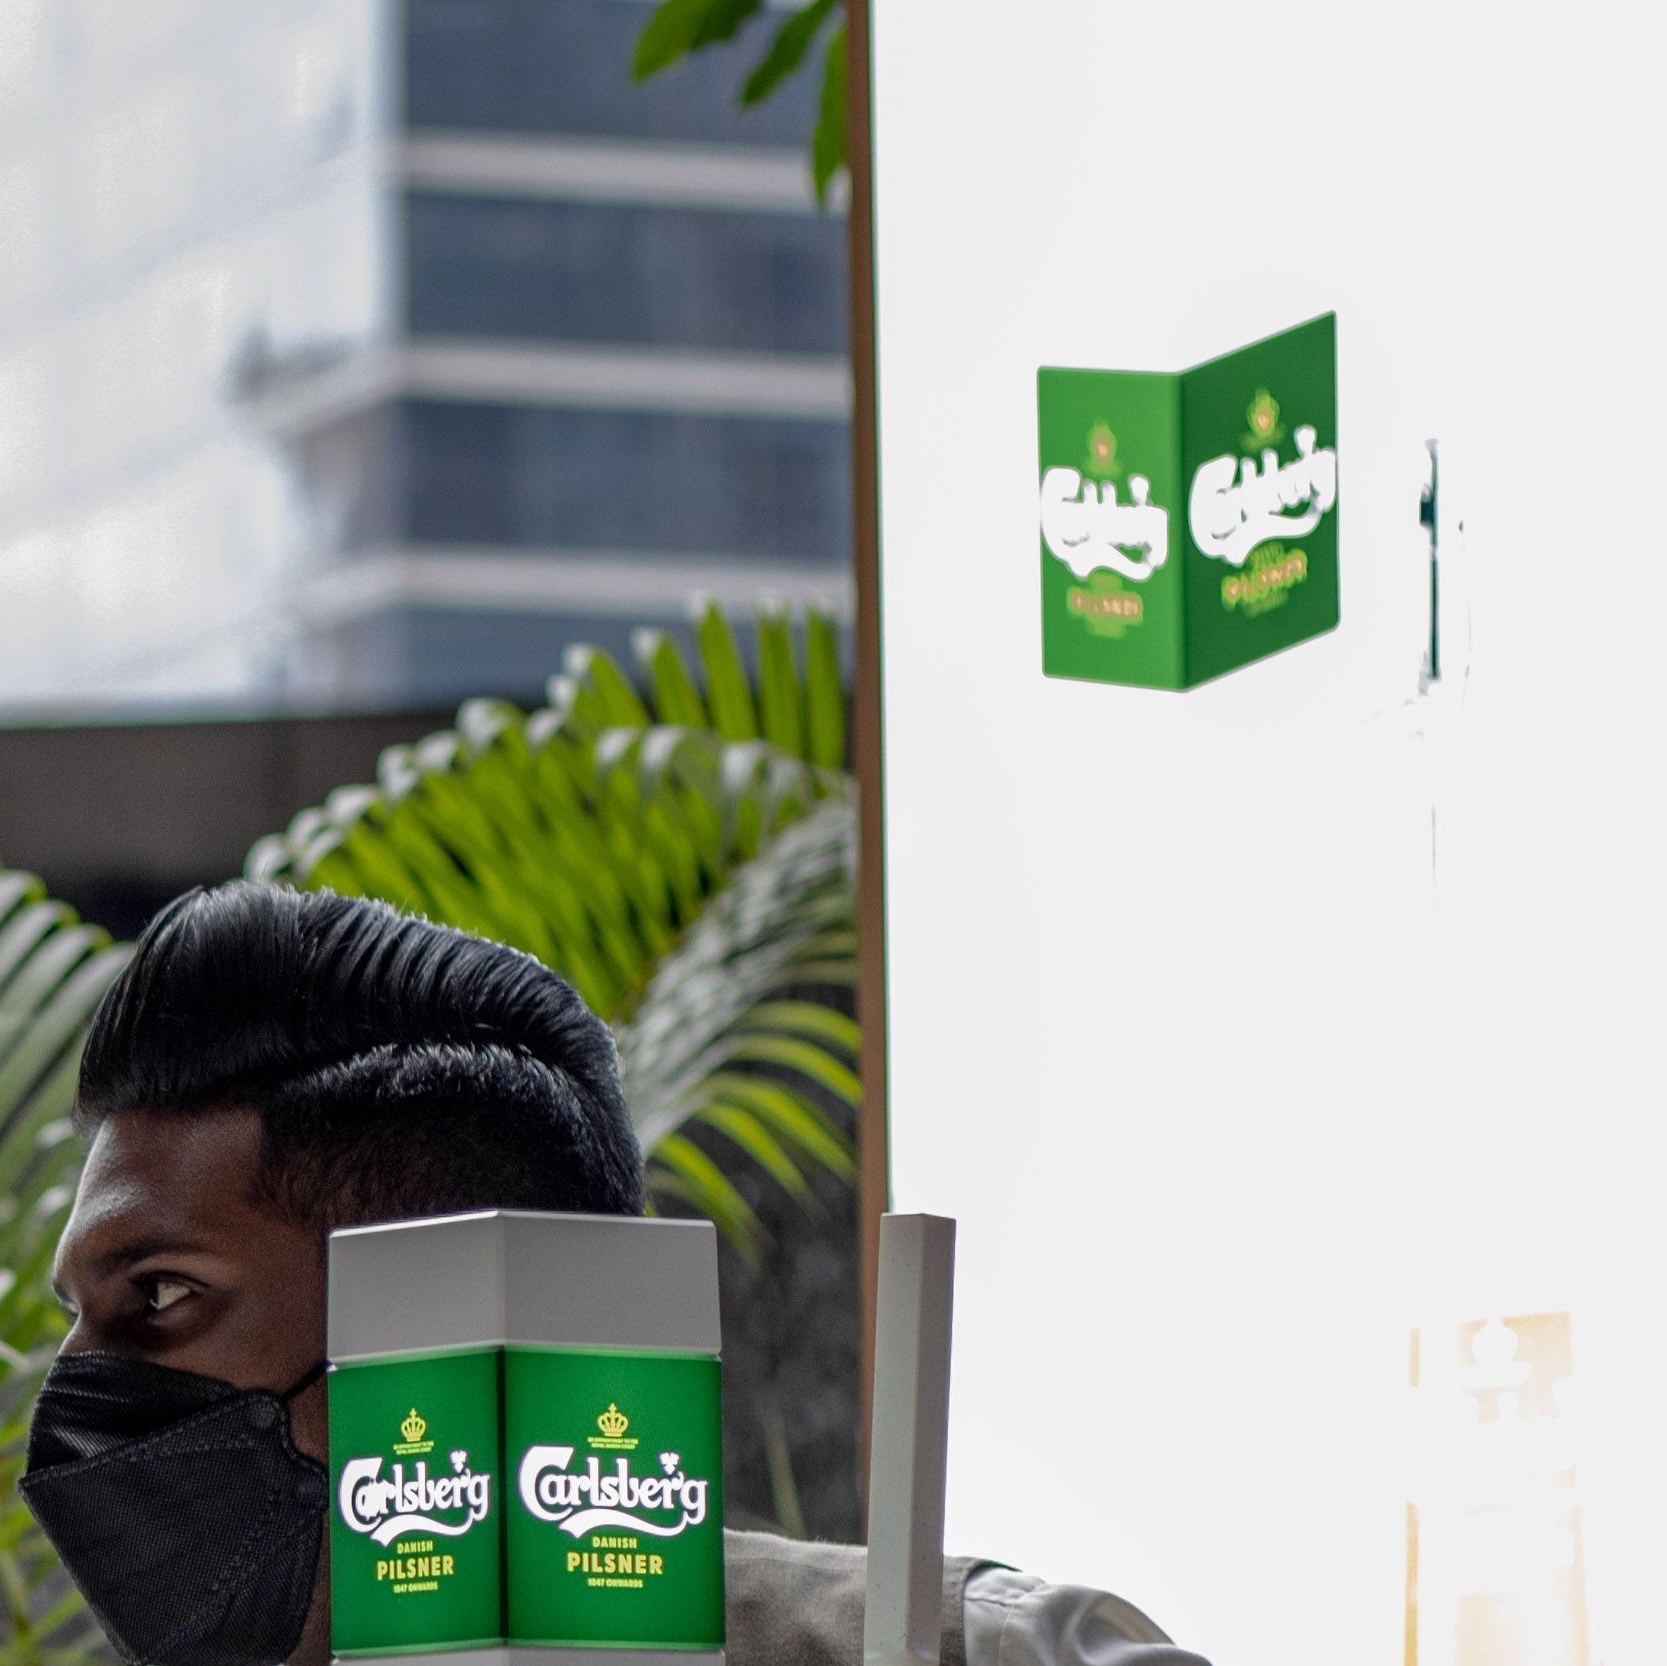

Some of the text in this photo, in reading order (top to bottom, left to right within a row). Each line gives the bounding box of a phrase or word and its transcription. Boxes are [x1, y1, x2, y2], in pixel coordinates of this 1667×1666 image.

[337, 1450, 491, 1547] Carlsberg
[516, 1445, 708, 1538] Carlsberg
[397, 1540, 434, 1555] DANISH
[592, 1536, 638, 1550] DANISH
[377, 1555, 455, 1581] PILSNER
[567, 1552, 664, 1576] PILSNER
